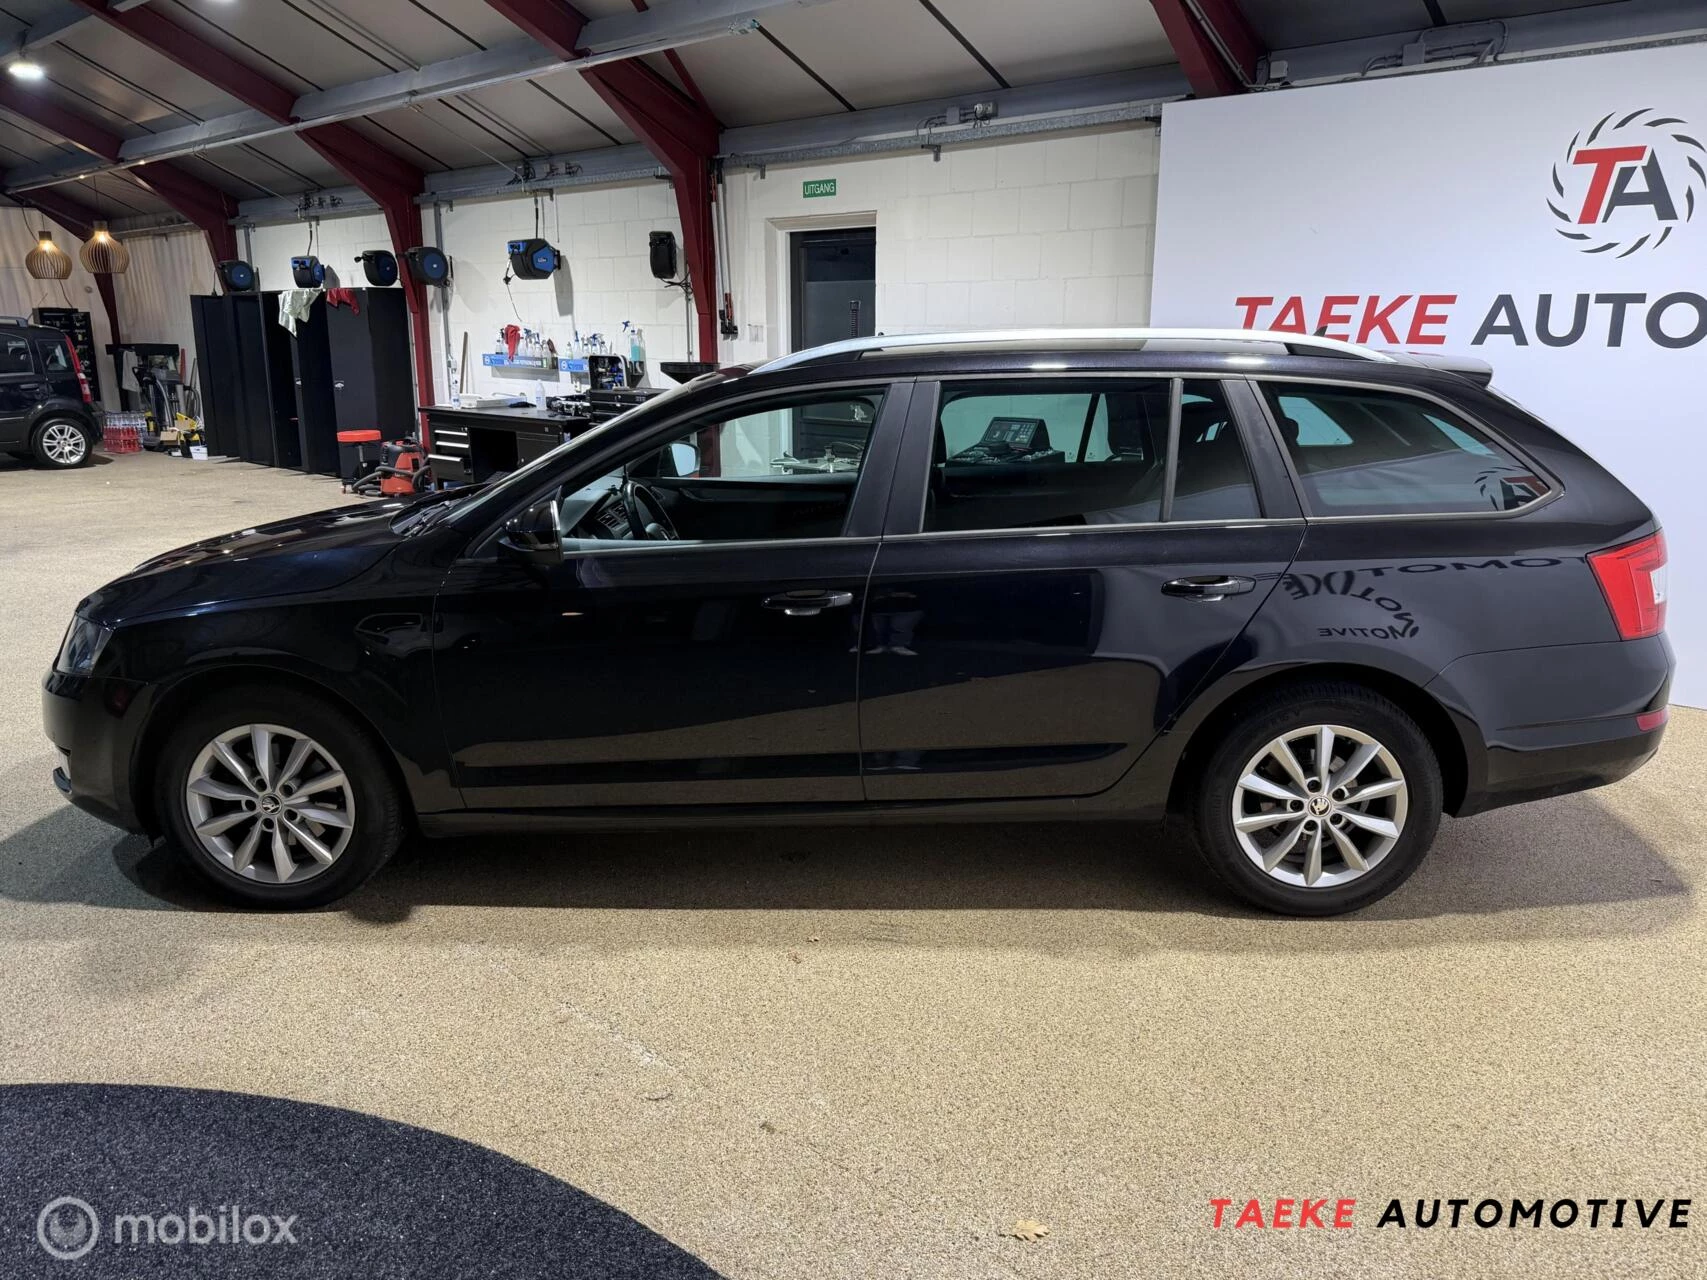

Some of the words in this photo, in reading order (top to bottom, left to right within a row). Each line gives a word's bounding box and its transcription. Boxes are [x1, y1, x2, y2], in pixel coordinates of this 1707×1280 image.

[804, 182, 835, 195] UITGANG
[1572, 145, 1678, 225] TA
[1235, 294, 1458, 345] TAEKE
[1470, 291, 1707, 349] AUTO
